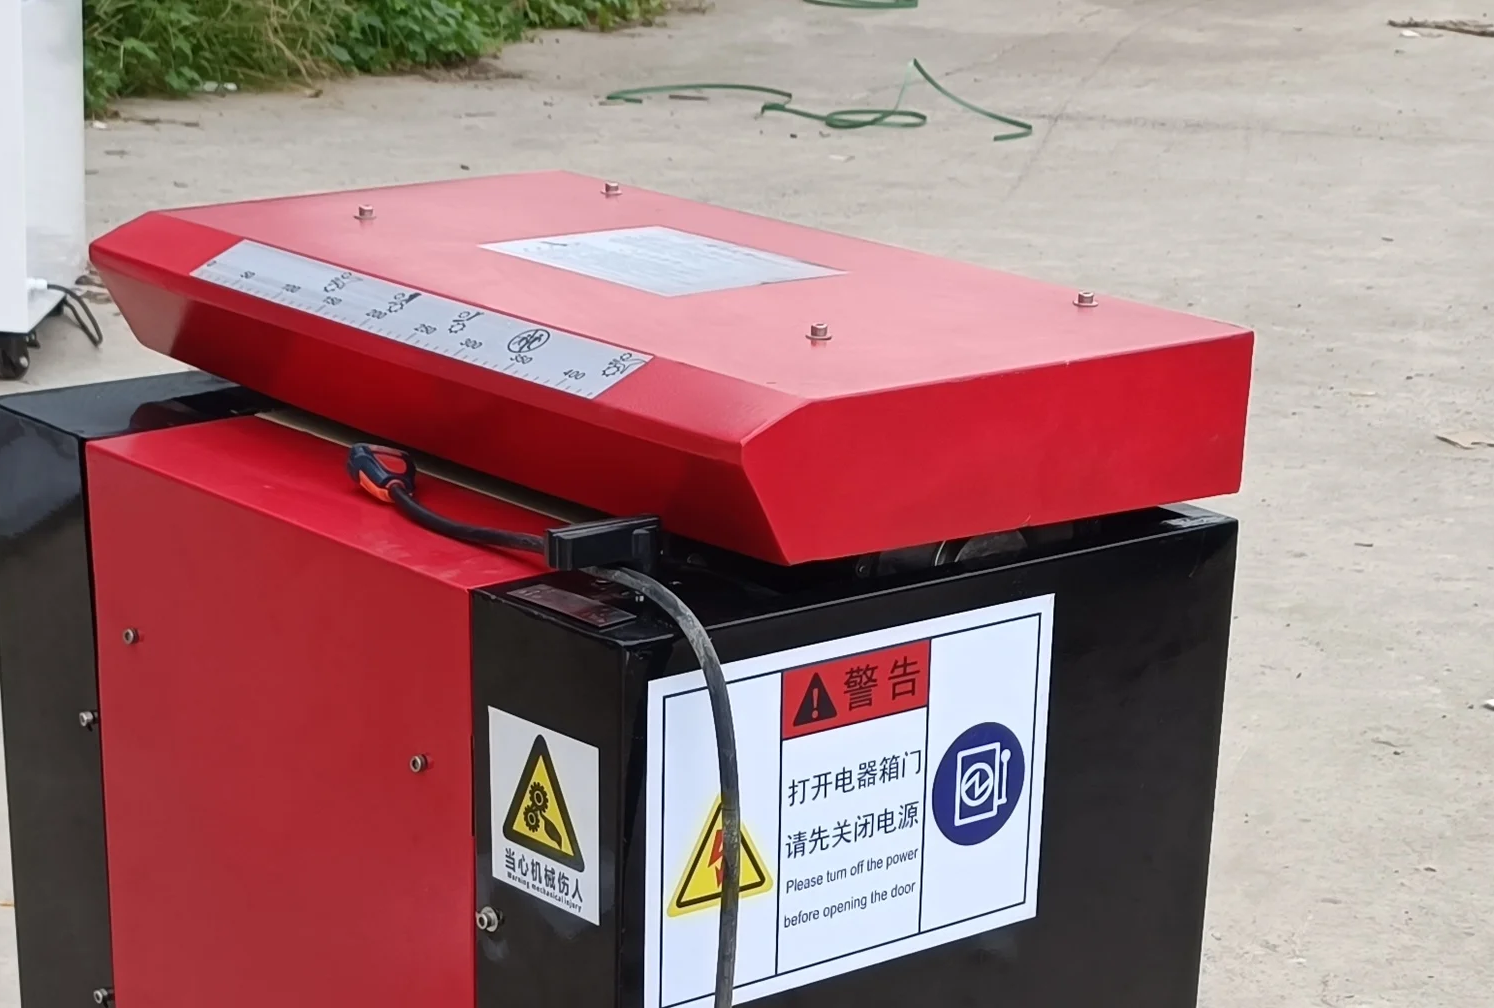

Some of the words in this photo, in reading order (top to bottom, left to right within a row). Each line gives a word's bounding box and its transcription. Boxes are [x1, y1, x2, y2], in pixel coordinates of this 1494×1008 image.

[365, 309, 387, 319] 200
[414, 323, 437, 335] 250
[460, 338, 483, 350] 300
[563, 369, 586, 381] 400
[844, 656, 921, 711] 警告
[787, 749, 922, 807] 打开电器箱门
[785, 801, 920, 859] 请先关闭电源
[505, 847, 583, 903] 当心机械伤人
[786, 874, 823, 894] Please
[826, 867, 847, 883] turn
[850, 860, 865, 876] off
[867, 857, 883, 872] the
[886, 848, 919, 870] power
[784, 910, 819, 928] before
[822, 896, 867, 919] opening
[870, 890, 888, 904] the
[890, 882, 916, 898] door
